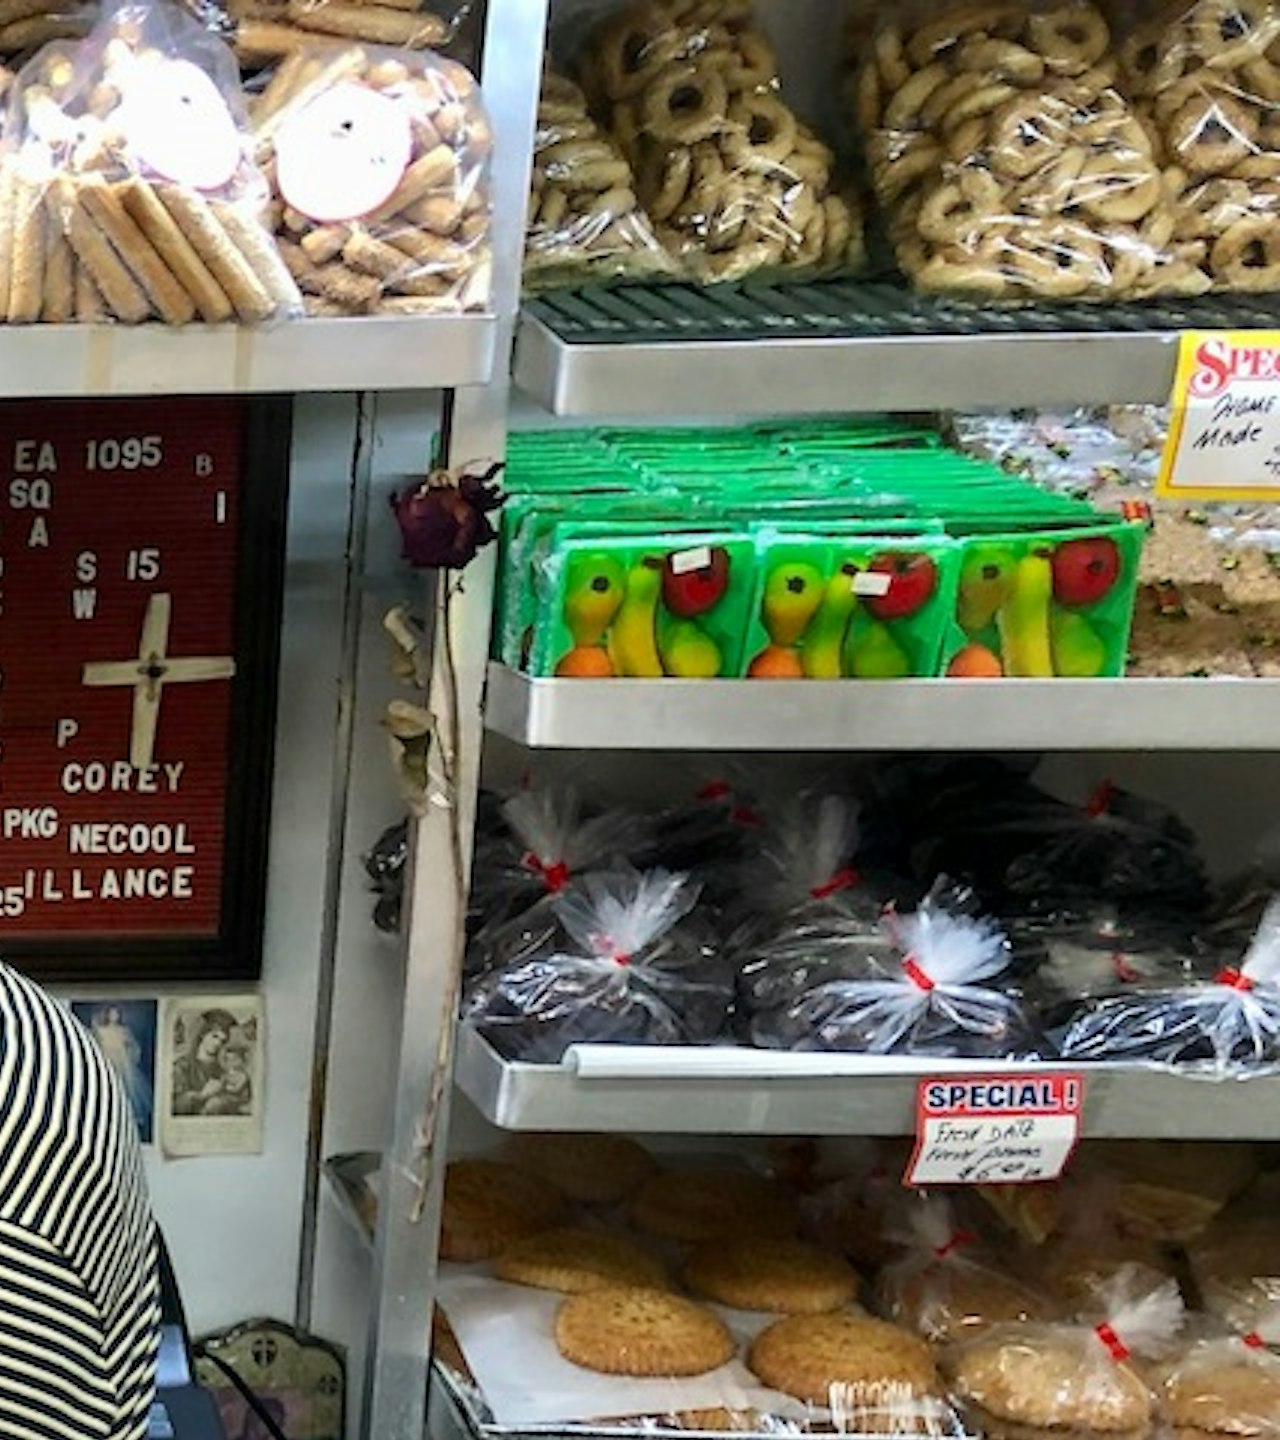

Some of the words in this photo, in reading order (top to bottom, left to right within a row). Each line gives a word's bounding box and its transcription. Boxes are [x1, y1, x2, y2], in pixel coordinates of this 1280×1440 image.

[1191, 340, 1280, 398] SPE
[14, 441, 57, 472] EA
[86, 437, 163, 471] 1095
[9, 478, 52, 509] SQ
[77, 551, 98, 583] S
[128, 549, 160, 580] 15
[60, 760, 184, 794] COREY
[2, 806, 59, 840] PKG
[68, 823, 196, 856] NECOOL
